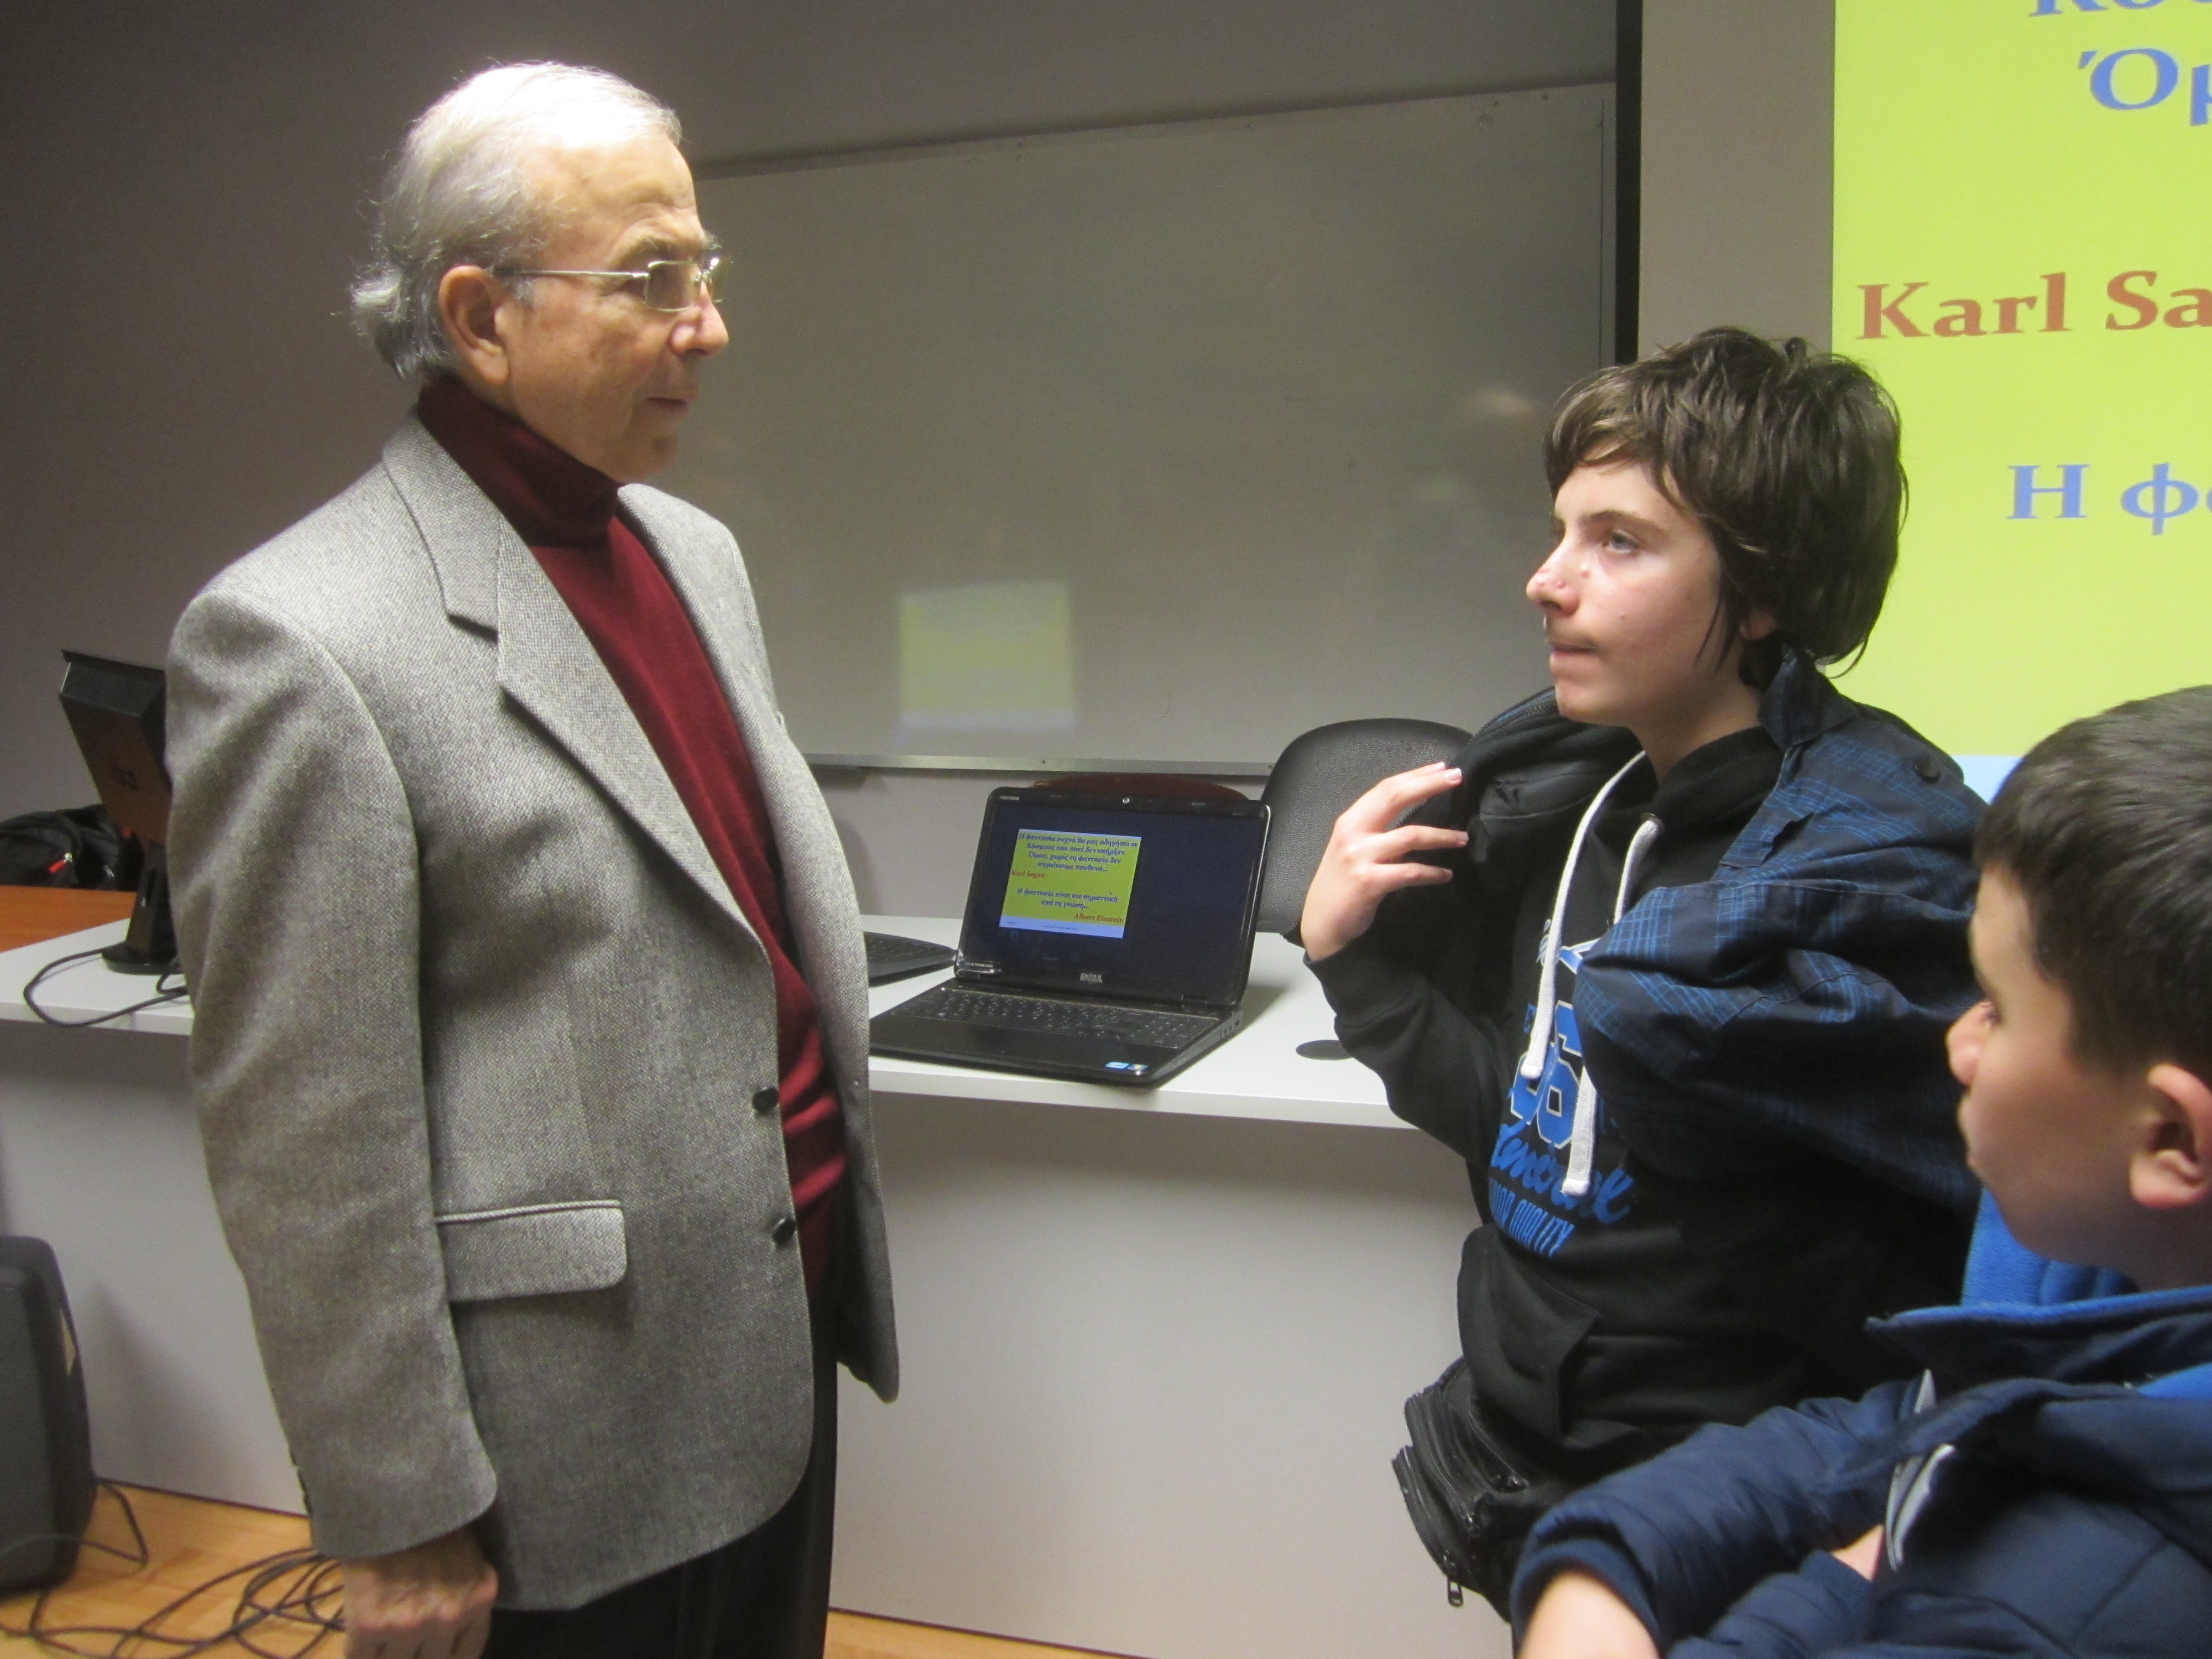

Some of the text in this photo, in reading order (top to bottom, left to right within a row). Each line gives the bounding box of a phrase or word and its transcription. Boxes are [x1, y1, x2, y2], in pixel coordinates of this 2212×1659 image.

[1856, 270, 2072, 339] Karl
[2120, 462, 2212, 536] φ
[1026, 870, 1045, 879] Sagan
[1074, 912, 1124, 923] Albert Einstein
